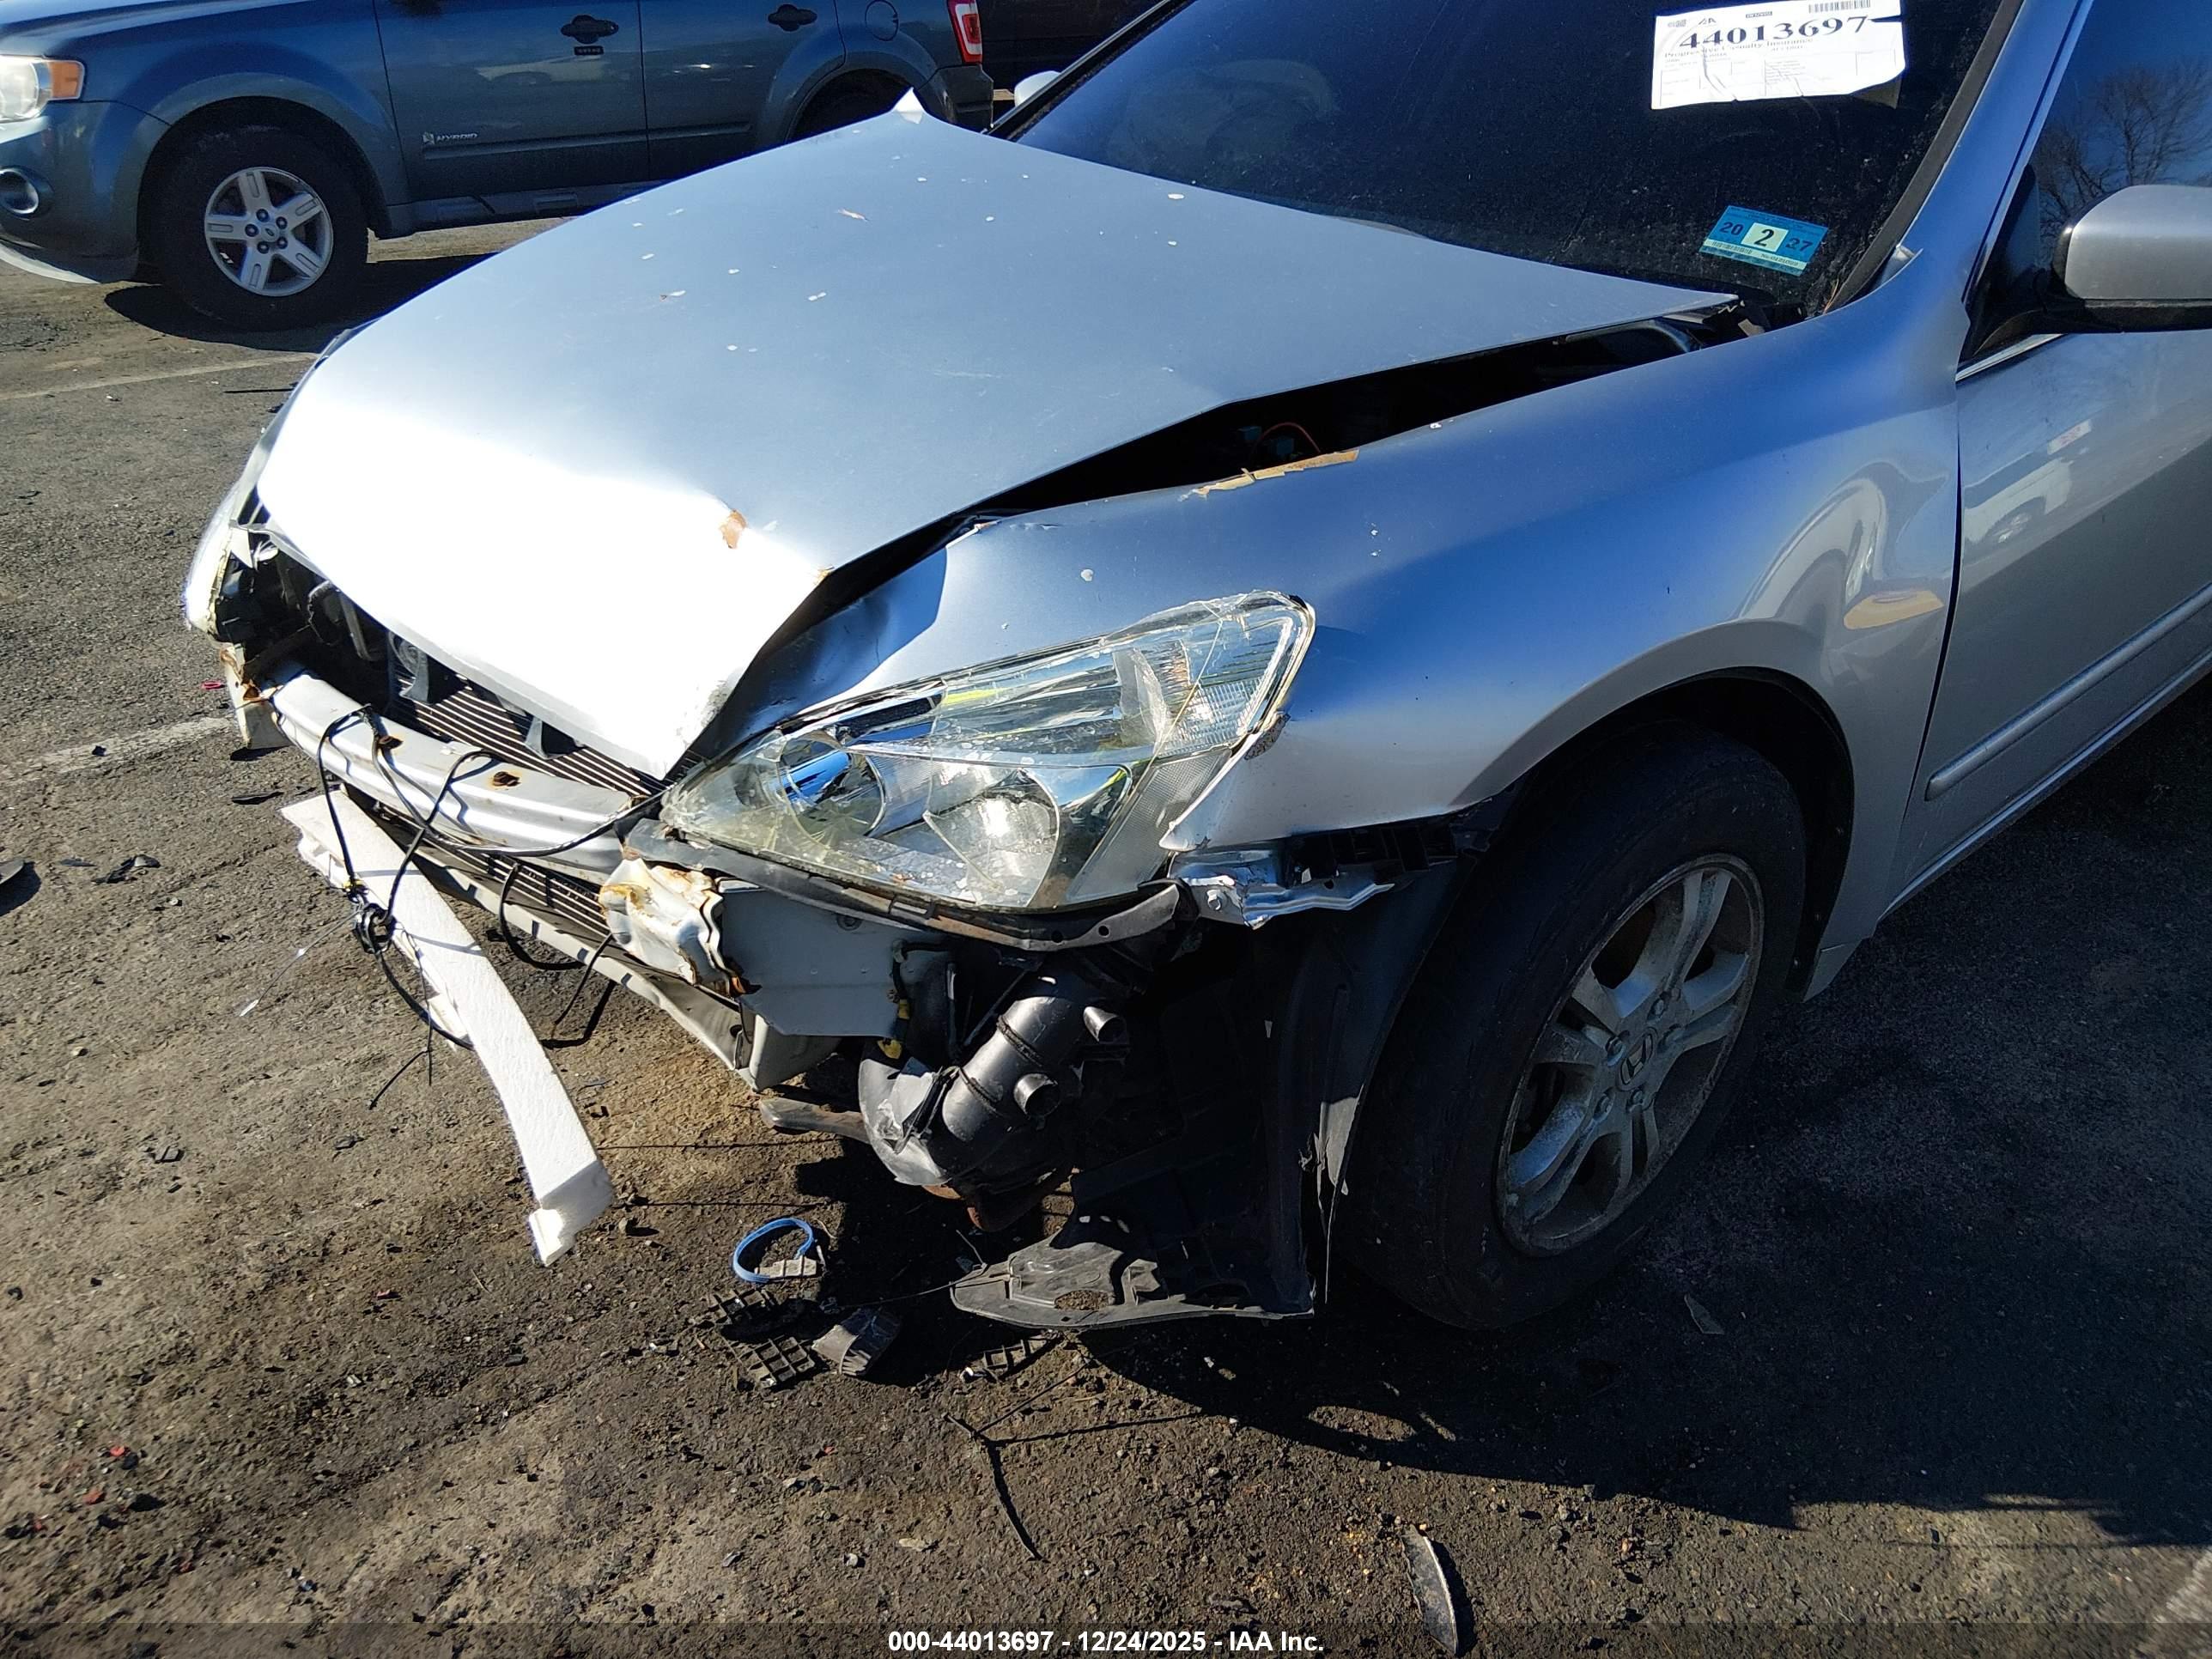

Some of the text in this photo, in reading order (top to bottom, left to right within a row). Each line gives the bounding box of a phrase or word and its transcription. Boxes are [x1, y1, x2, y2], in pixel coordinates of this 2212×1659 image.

[1679, 16, 1868, 48] 44013697
[1720, 222, 1744, 235] 20
[1753, 229, 1775, 246] 2
[1785, 238, 1813, 252] 27
